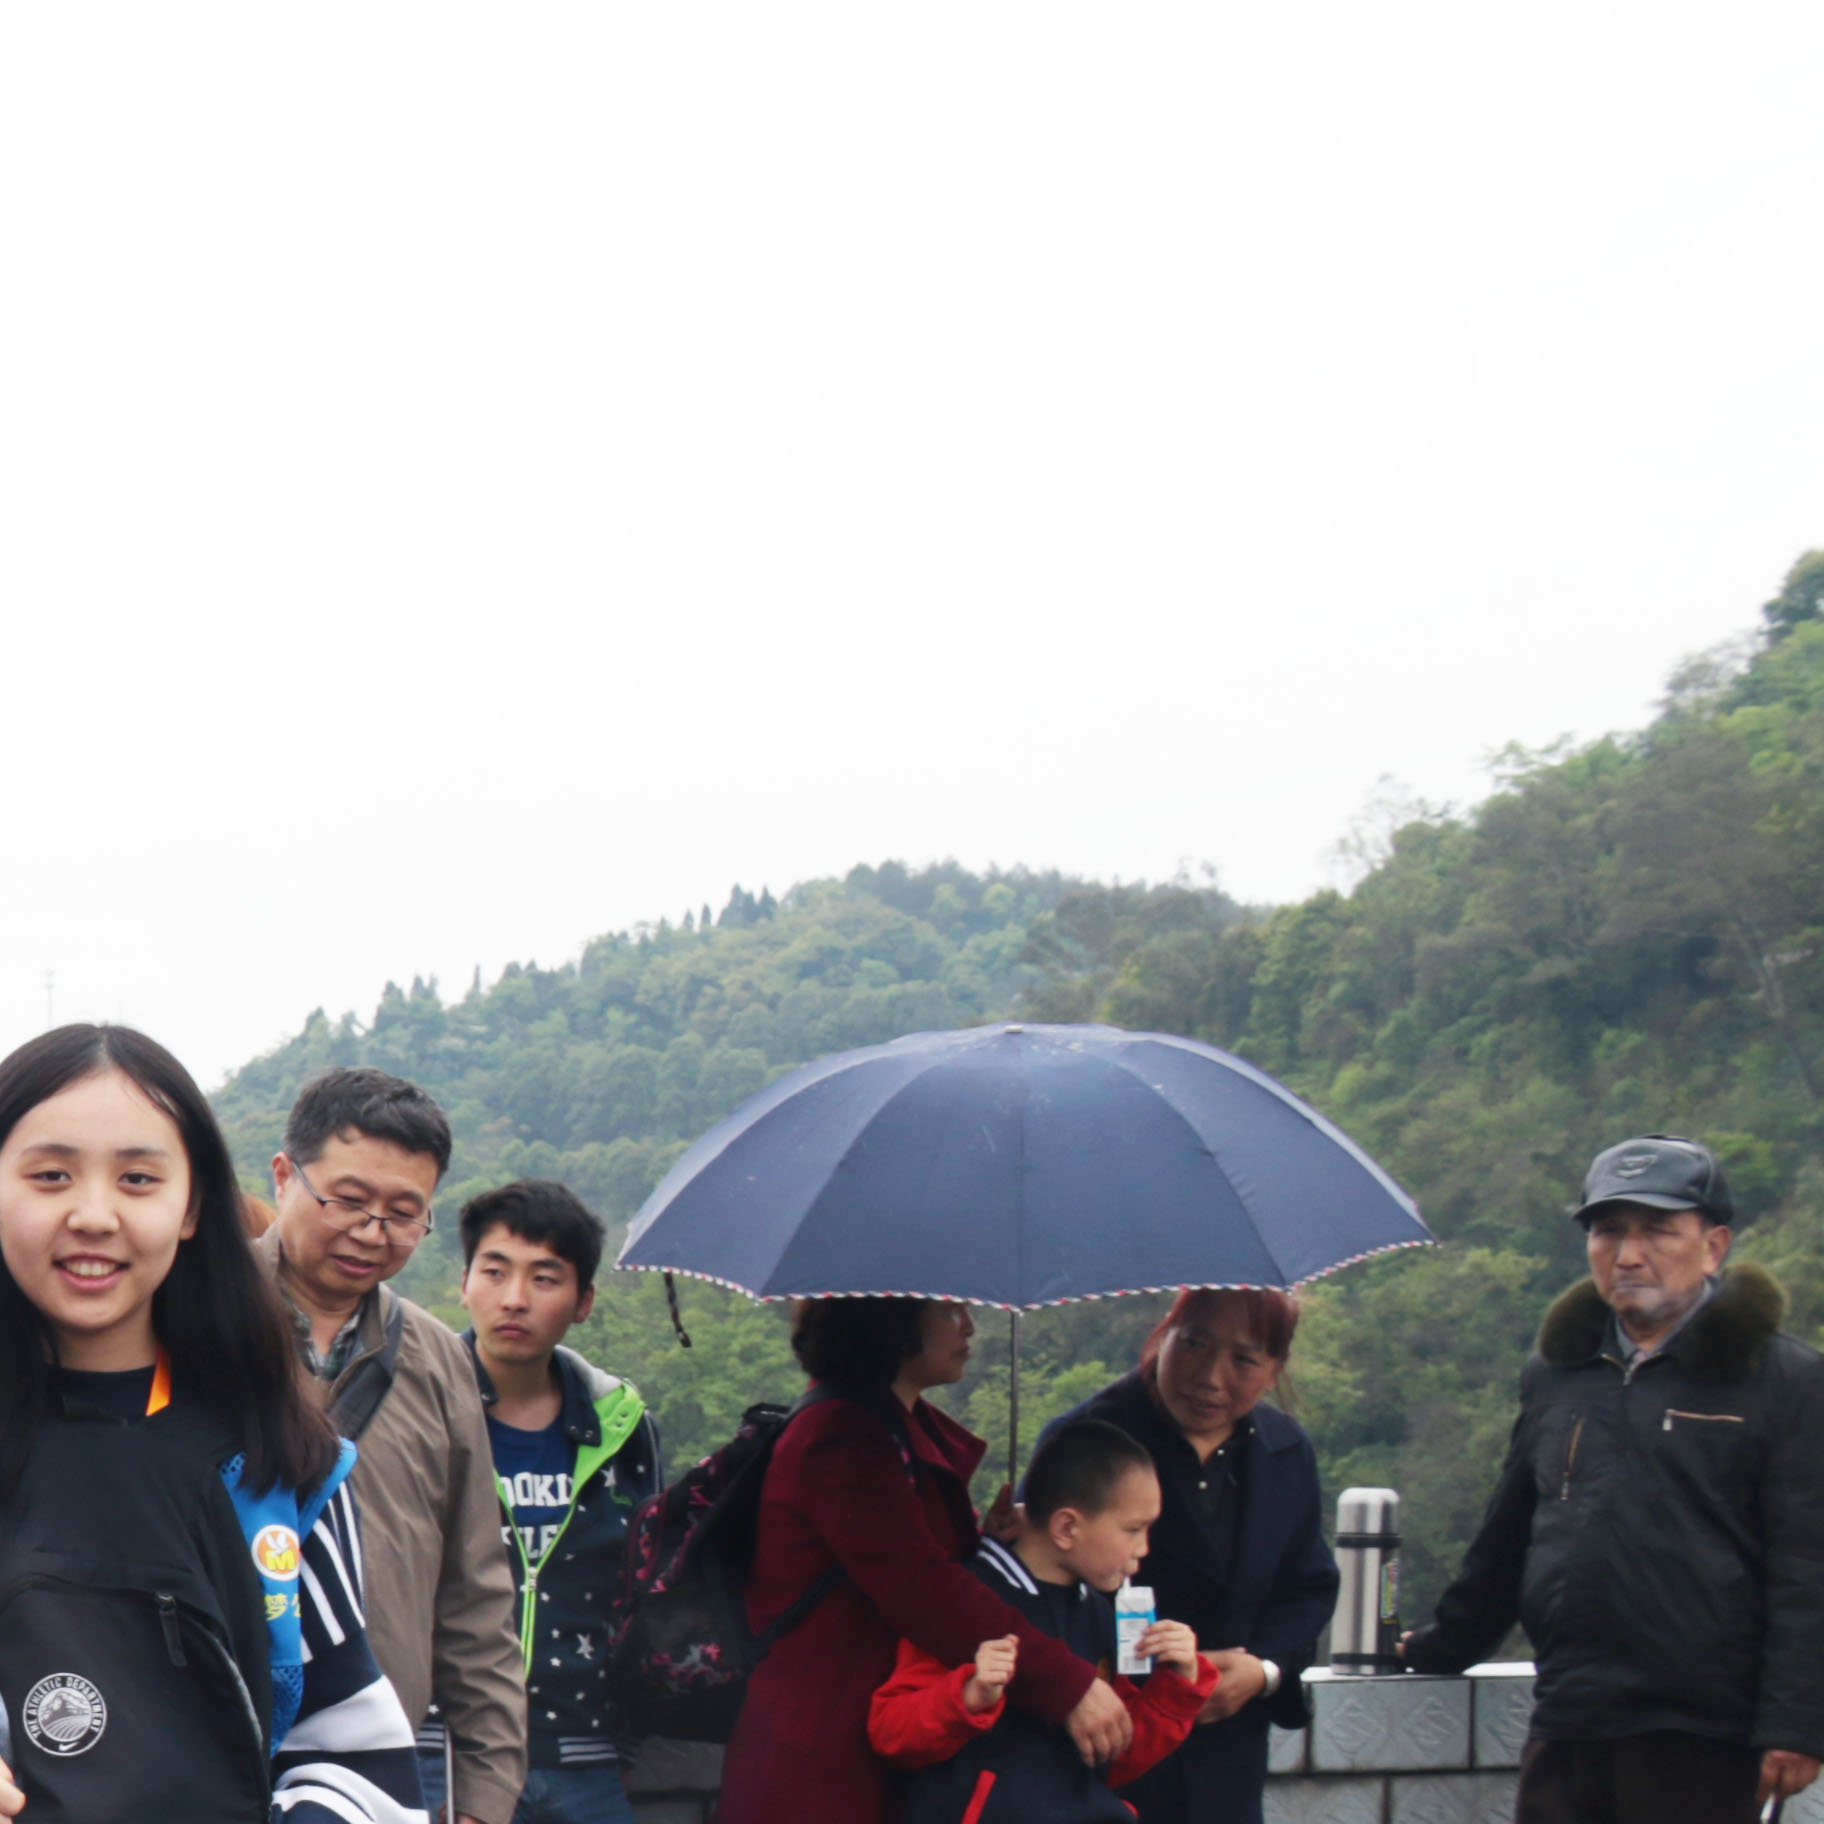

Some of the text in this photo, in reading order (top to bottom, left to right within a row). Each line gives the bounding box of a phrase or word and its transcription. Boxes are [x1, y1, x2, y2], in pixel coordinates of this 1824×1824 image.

[27, 1675, 103, 1740] THE ATHLETIC DEPARTMENT
